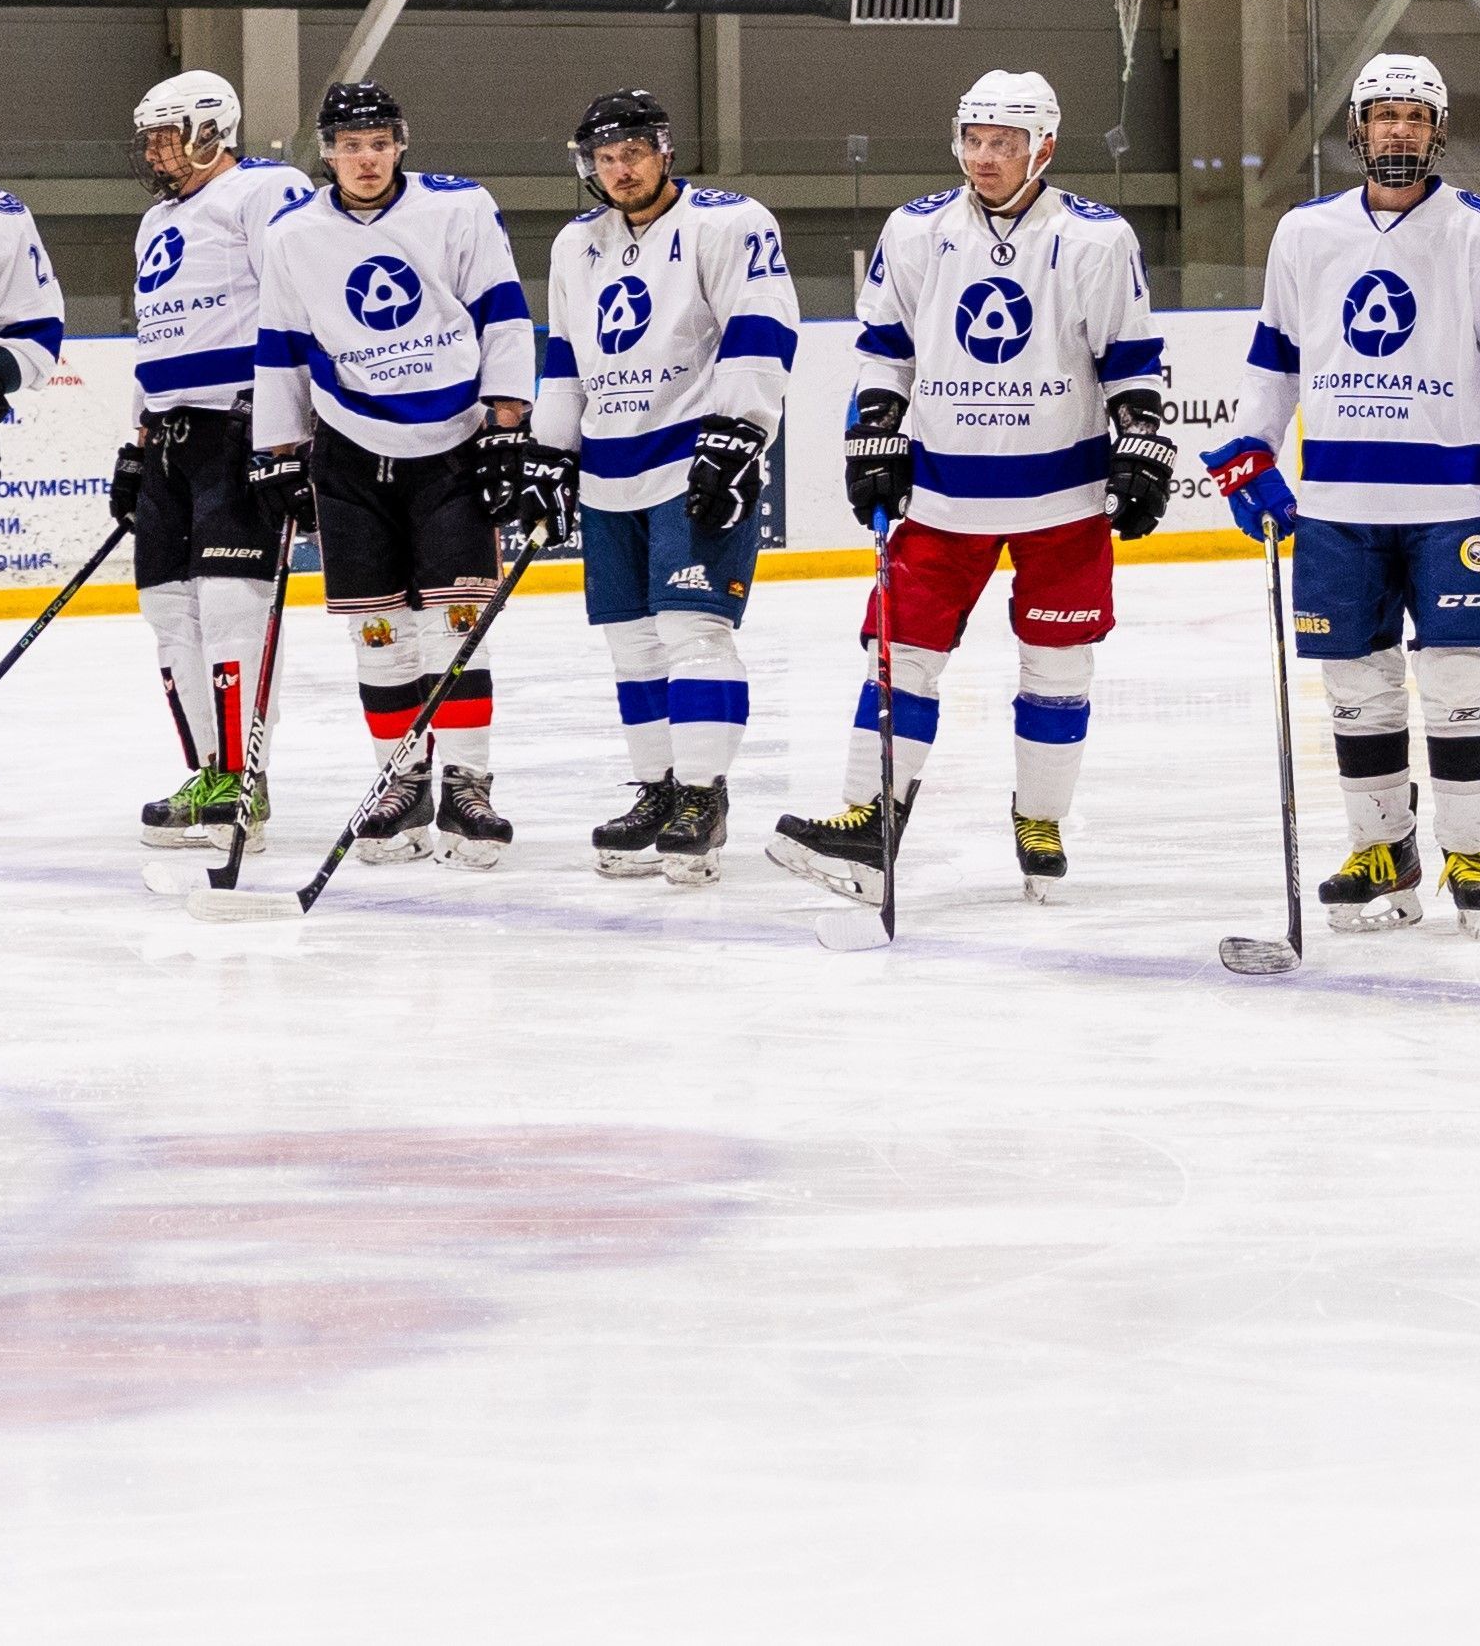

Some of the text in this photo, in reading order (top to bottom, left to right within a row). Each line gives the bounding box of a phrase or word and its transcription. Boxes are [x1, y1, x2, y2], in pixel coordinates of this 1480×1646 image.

[1385, 72, 1416, 81] CCM
[743, 228, 790, 283] 22
[191, 294, 228, 311] АЭС
[369, 361, 433, 381] РОСАТОМ
[1416, 377, 1455, 398] АЭС
[956, 412, 1031, 427] РОСАТОМ
[1337, 404, 1410, 420] РОСАТОМ
[845, 437, 910, 457] ARRIOR
[248, 460, 302, 483] RUE
[523, 461, 565, 480] CM
[349, 729, 420, 838] FISCHER
